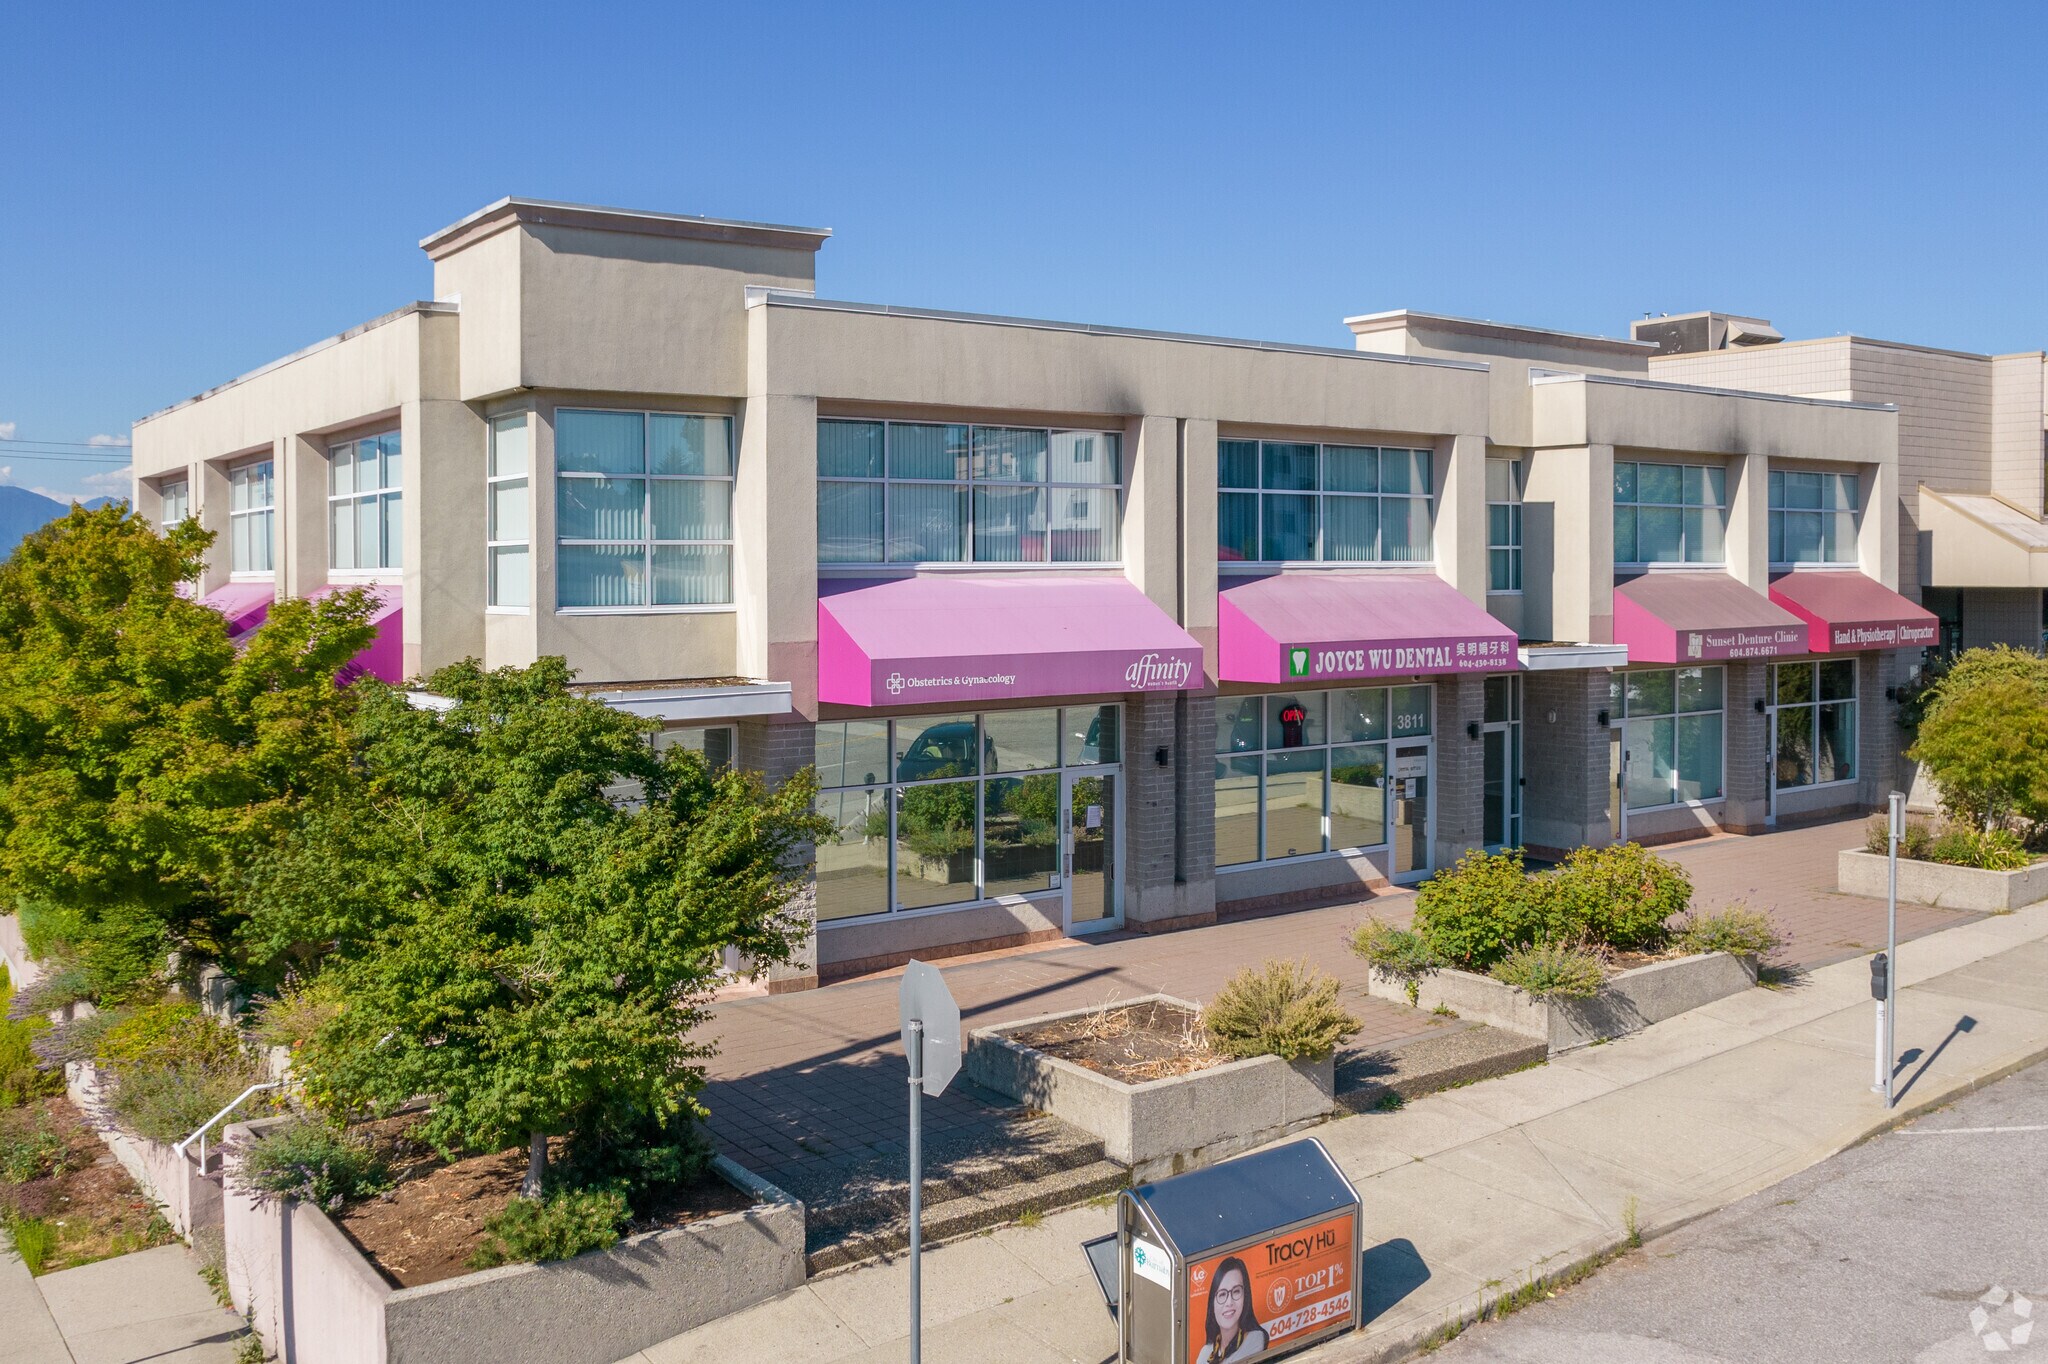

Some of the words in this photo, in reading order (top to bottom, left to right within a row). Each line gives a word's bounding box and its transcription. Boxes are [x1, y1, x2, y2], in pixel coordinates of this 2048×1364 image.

[1706, 634, 1735, 647] Sunset
[1738, 633, 1772, 645] Denture
[1775, 631, 1798, 643] Clinic
[1835, 629, 1850, 644] Hand
[1851, 629, 1857, 643] &
[1857, 627, 1896, 646] Physiotherapy
[1900, 626, 1934, 643] Chiropractor
[1316, 650, 1364, 673] JOYCE
[1369, 649, 1393, 670] WU
[1396, 646, 1452, 669] DENTAL
[1729, 646, 1777, 657] 604.874.6671
[1125, 653, 1192, 689] affinity
[907, 676, 952, 688] Obstetrics
[954, 676, 961, 685] &
[1283, 708, 1304, 722] OPEN
[1397, 713, 1424, 730] 3811
[1266, 1235, 1314, 1265] Tracy
[1295, 1269, 1326, 1292] TOP
[1269, 1295, 1349, 1337] 604-728-4546
